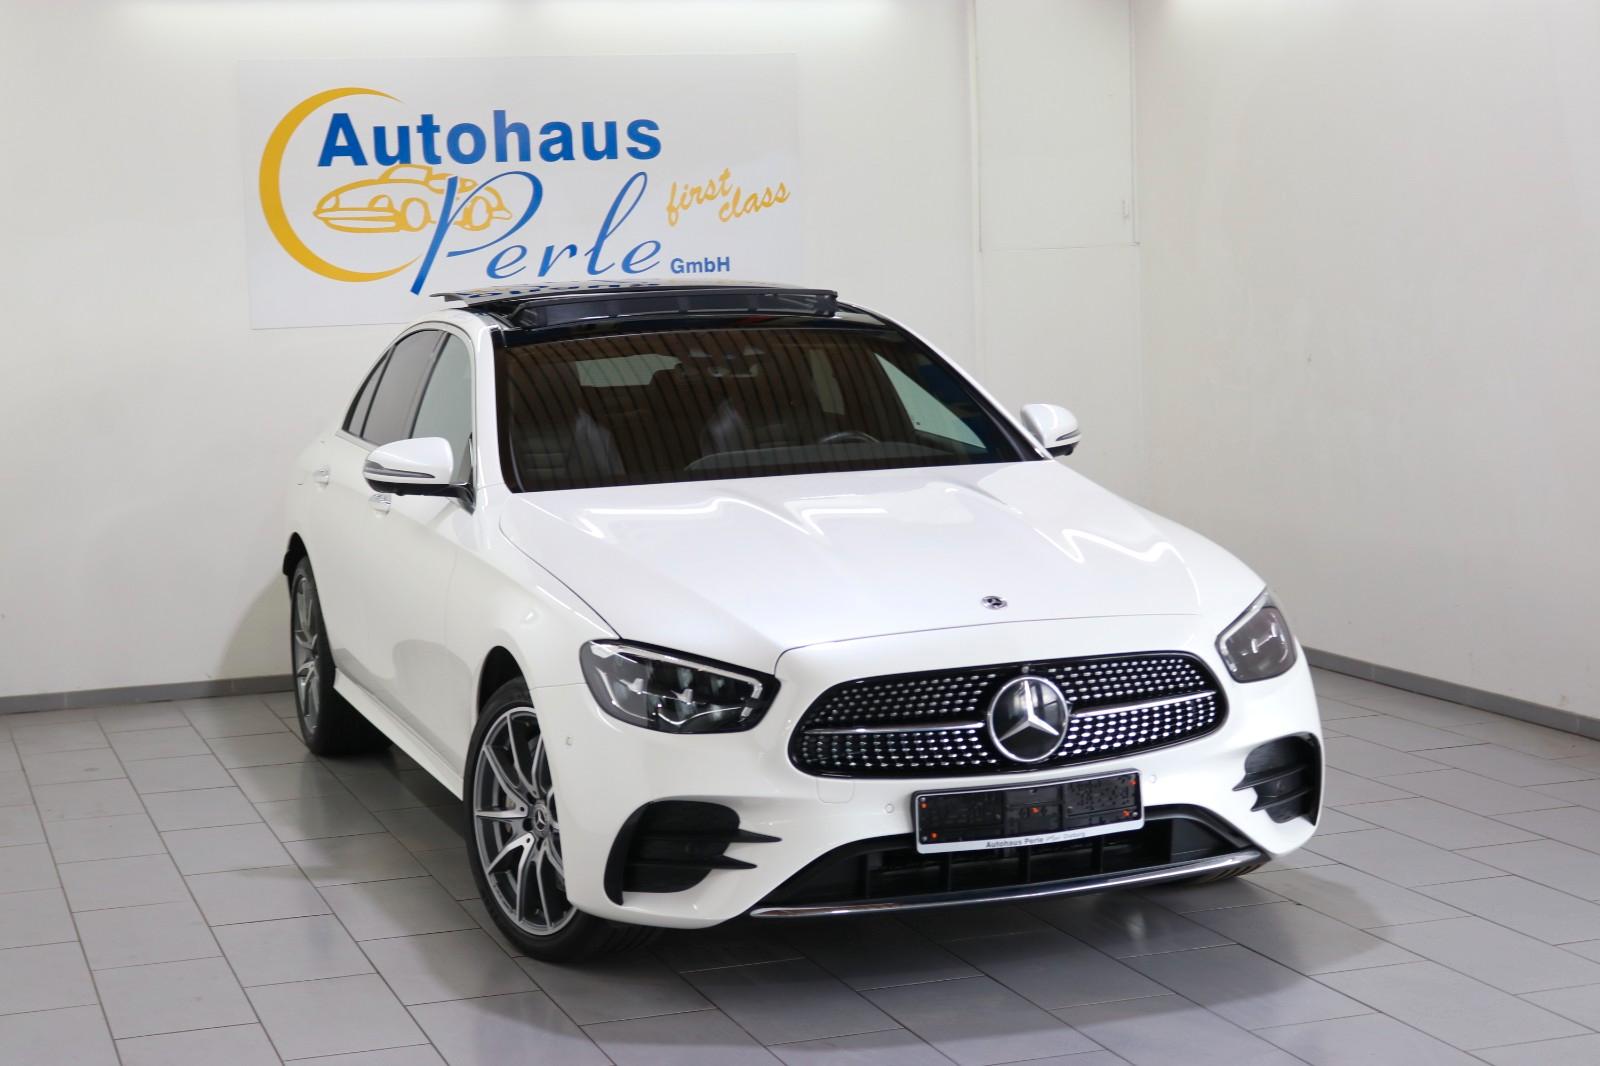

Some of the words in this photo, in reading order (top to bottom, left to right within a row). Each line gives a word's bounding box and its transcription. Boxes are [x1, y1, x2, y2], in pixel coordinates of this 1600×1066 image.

[318, 111, 661, 168] Autohaus
[667, 168, 734, 227] first
[718, 182, 791, 223] class
[411, 171, 661, 295] Perle
[670, 255, 731, 274] GmbH
[986, 839, 1022, 848] Autohaus
[1024, 837, 1044, 845] Perle
